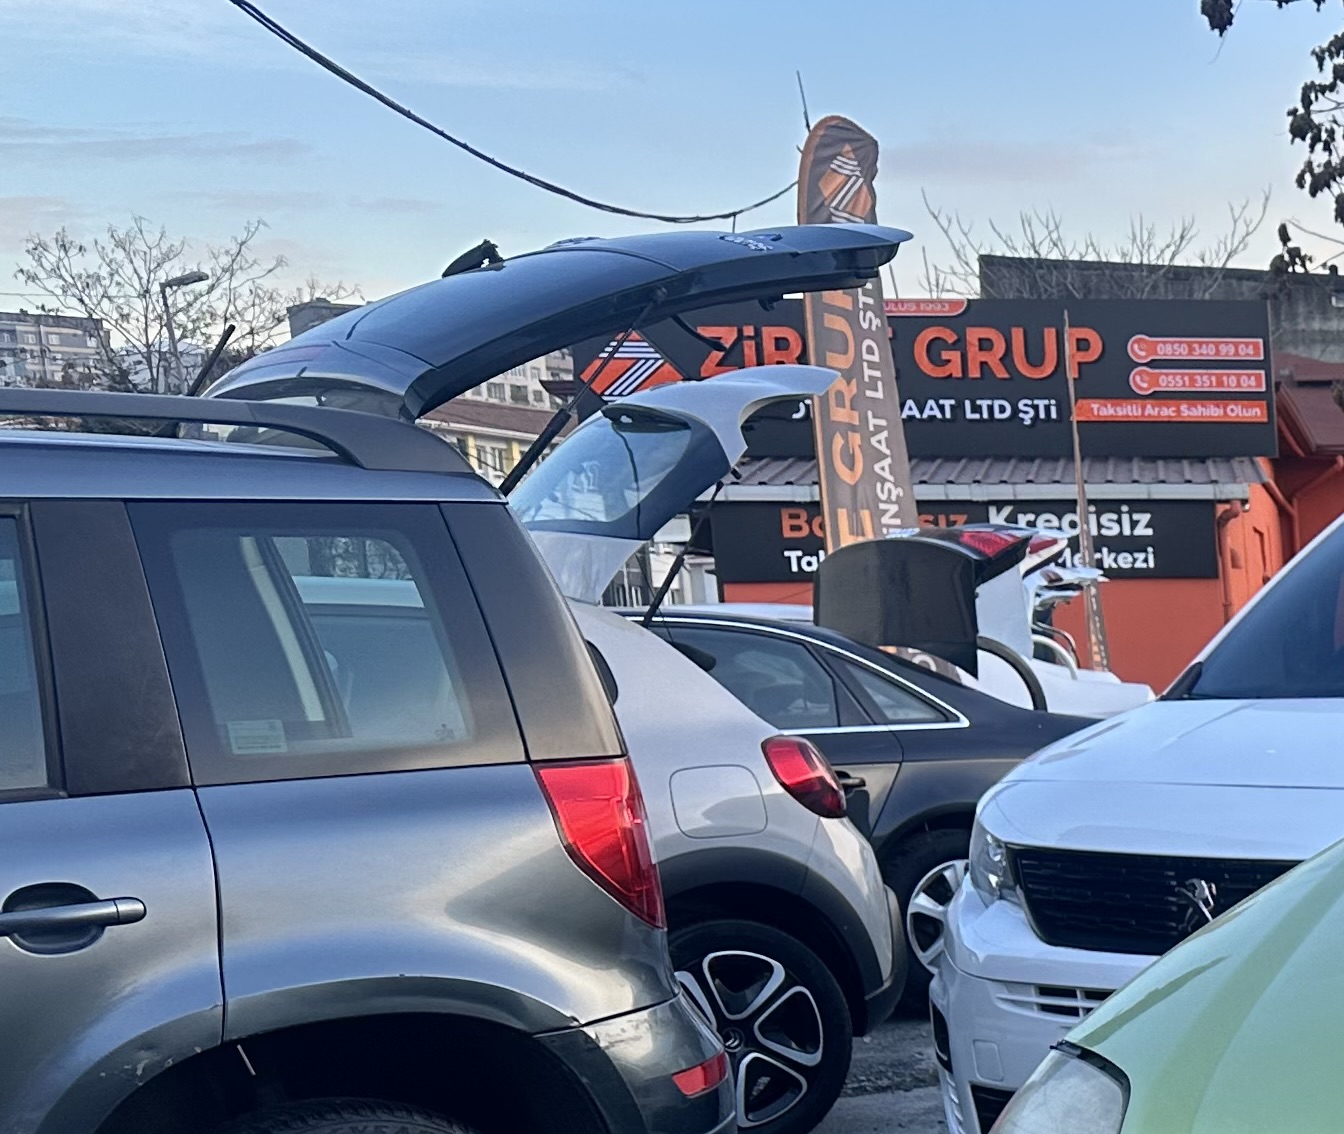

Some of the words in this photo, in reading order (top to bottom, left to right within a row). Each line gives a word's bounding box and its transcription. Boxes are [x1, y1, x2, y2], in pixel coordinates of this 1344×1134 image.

[914, 327, 1103, 379] GRUP
[1157, 343, 1188, 355] 0850
[1192, 343, 1215, 355] 340
[1238, 344, 1254, 355] 04
[861, 338, 884, 399] LTD
[1159, 375, 1190, 387] 0551
[1194, 375, 1216, 387] 351
[1240, 376, 1256, 387] 04
[964, 399, 1012, 420] LTD
[1091, 403, 1141, 417] Taksitli
[1180, 403, 1223, 417] Sahibi
[1226, 404, 1261, 417] Olun
